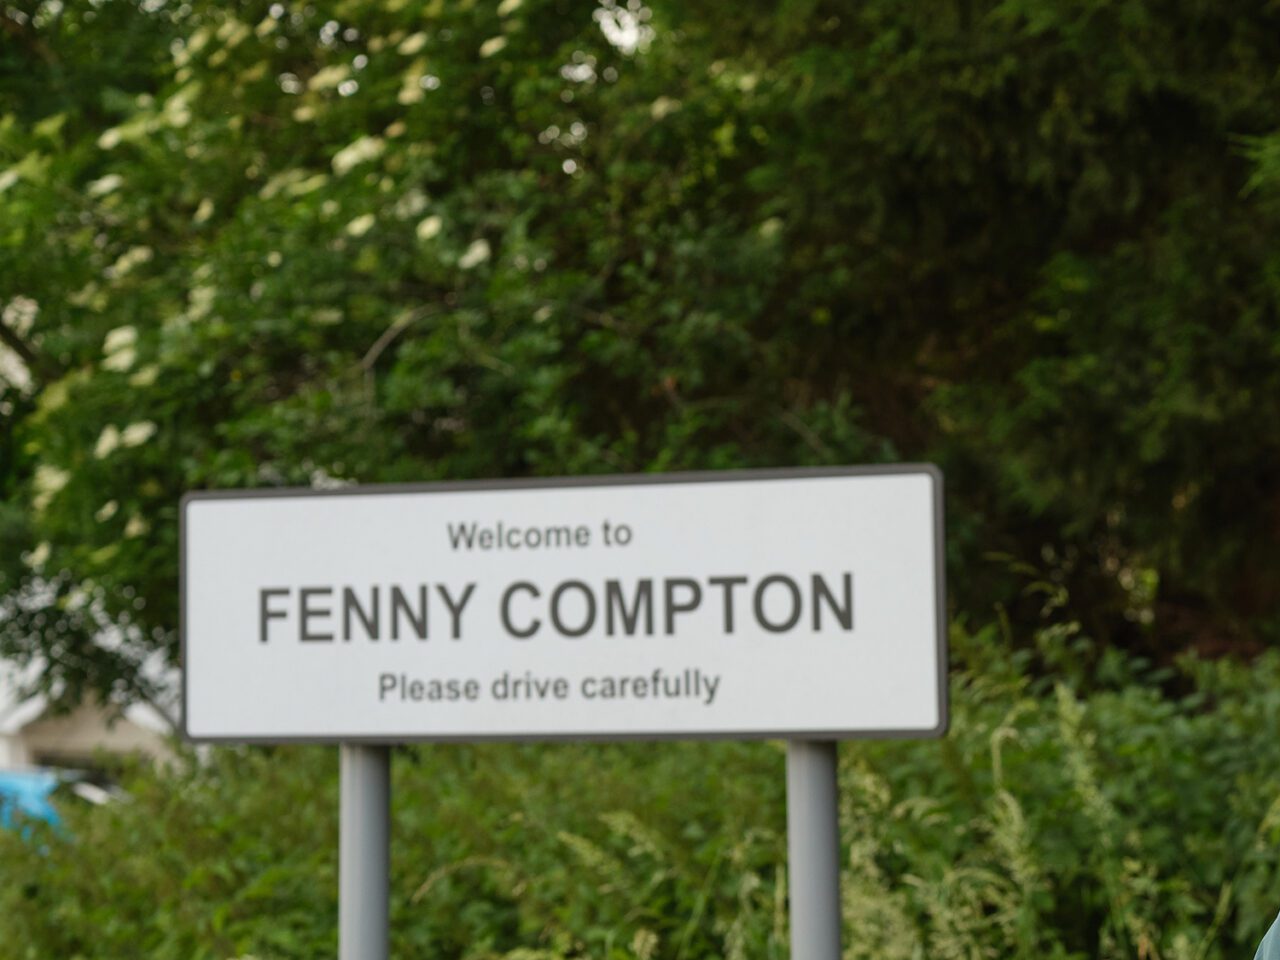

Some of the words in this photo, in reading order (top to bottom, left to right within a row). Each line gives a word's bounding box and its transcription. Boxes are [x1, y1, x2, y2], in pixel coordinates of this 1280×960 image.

[448, 522, 592, 549] Welcome
[602, 520, 632, 546] to
[258, 583, 476, 642] FENNY
[499, 572, 854, 639] COMPTON
[379, 673, 480, 700] Please
[491, 672, 568, 699] drive
[580, 669, 720, 704] carefully
